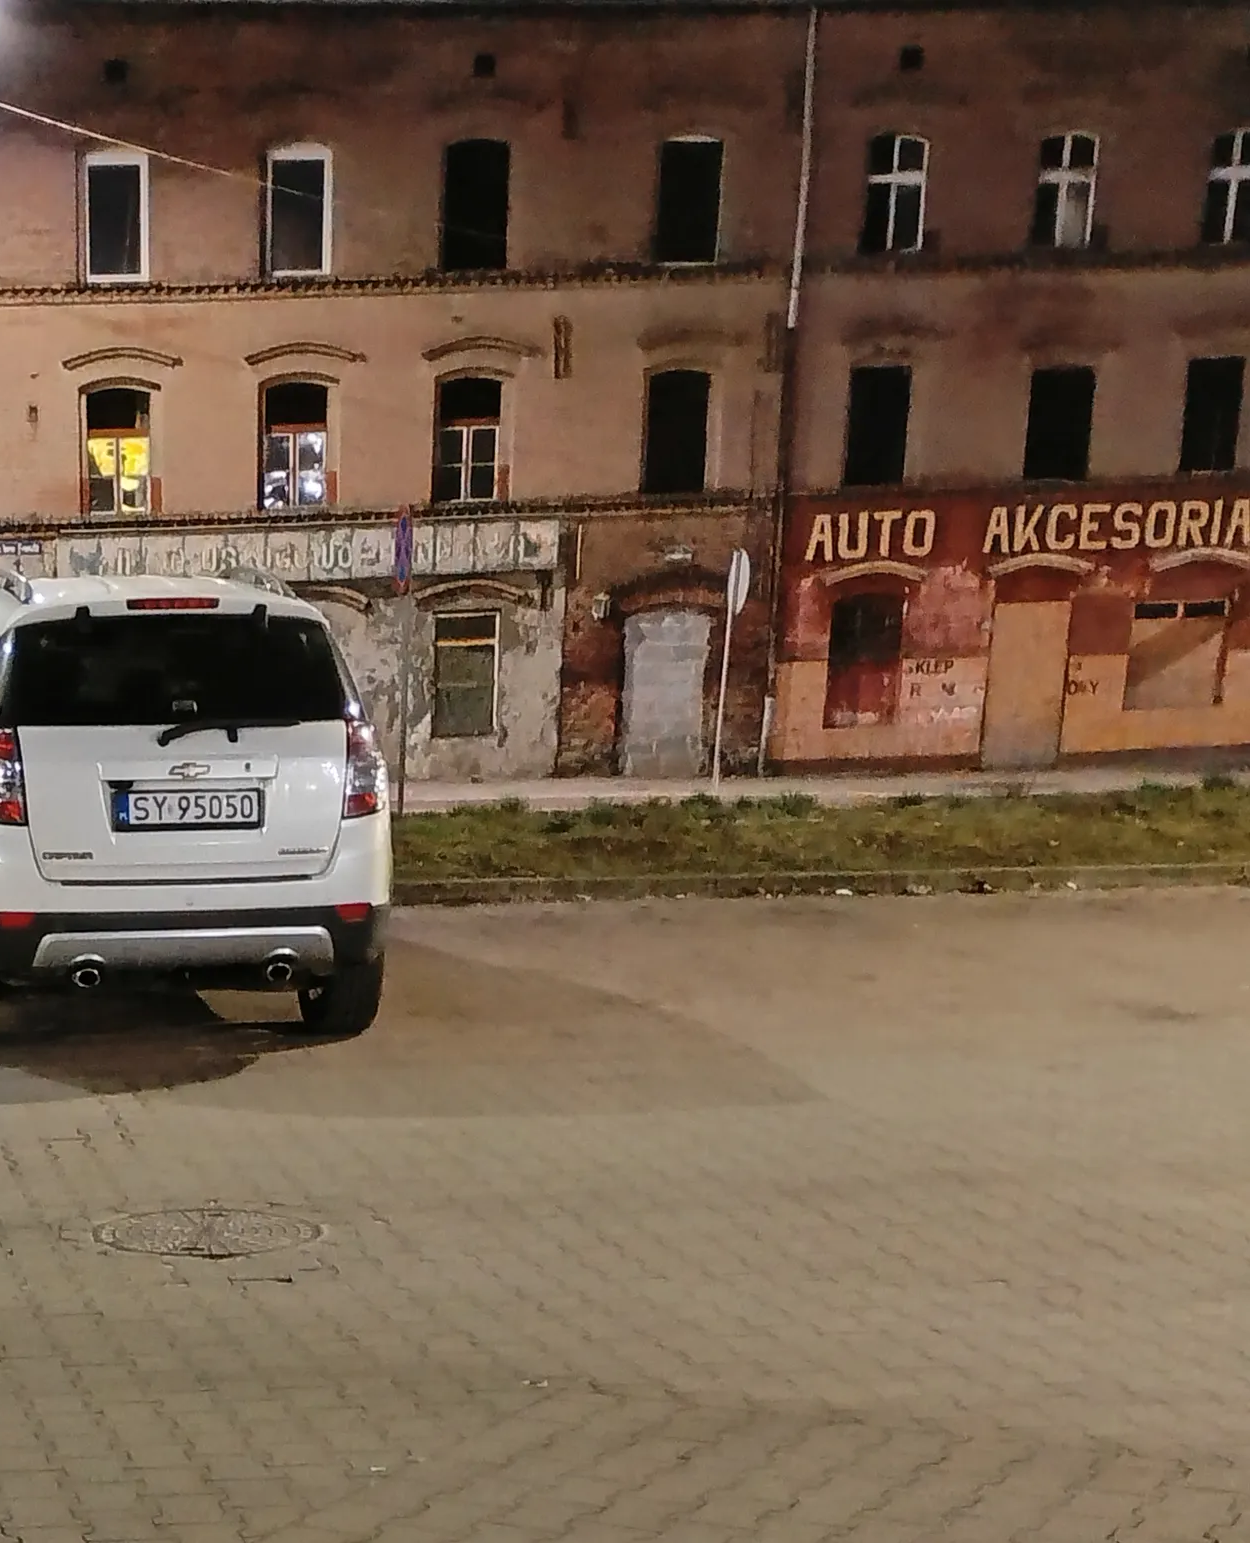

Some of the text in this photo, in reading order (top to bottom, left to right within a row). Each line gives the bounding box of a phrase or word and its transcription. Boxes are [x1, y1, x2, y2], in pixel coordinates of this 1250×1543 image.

[804, 497, 1250, 562] AUTO AKCESORIA
[133, 795, 168, 821] SY
[177, 794, 254, 820] 95050
